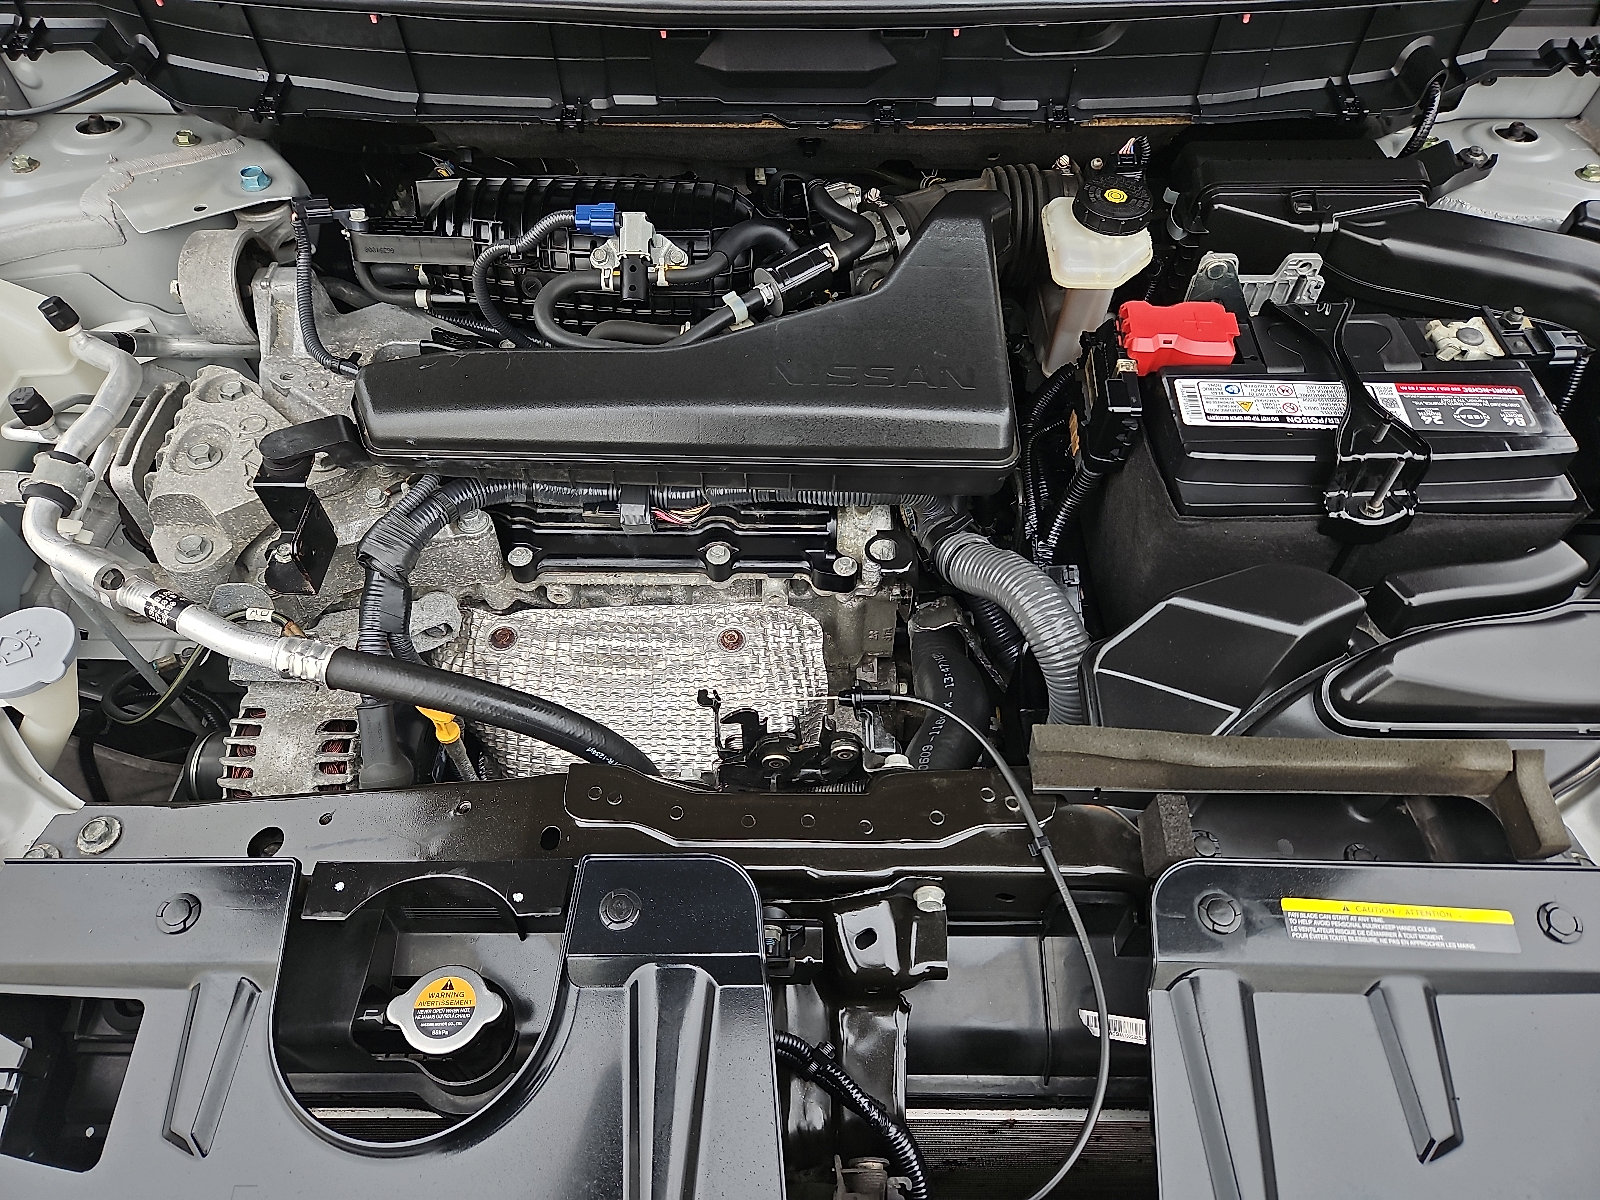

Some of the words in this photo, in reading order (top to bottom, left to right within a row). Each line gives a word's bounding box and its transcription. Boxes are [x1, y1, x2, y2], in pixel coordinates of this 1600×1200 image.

[768, 365, 976, 390] NISSAN
[1421, 415, 1444, 425] 24
[1355, 905, 1395, 914] CAUTION
[1405, 909, 1453, 919] ATTENTION
[428, 991, 465, 999] WARNING
[417, 999, 473, 1007] AVERTISSEMENT
